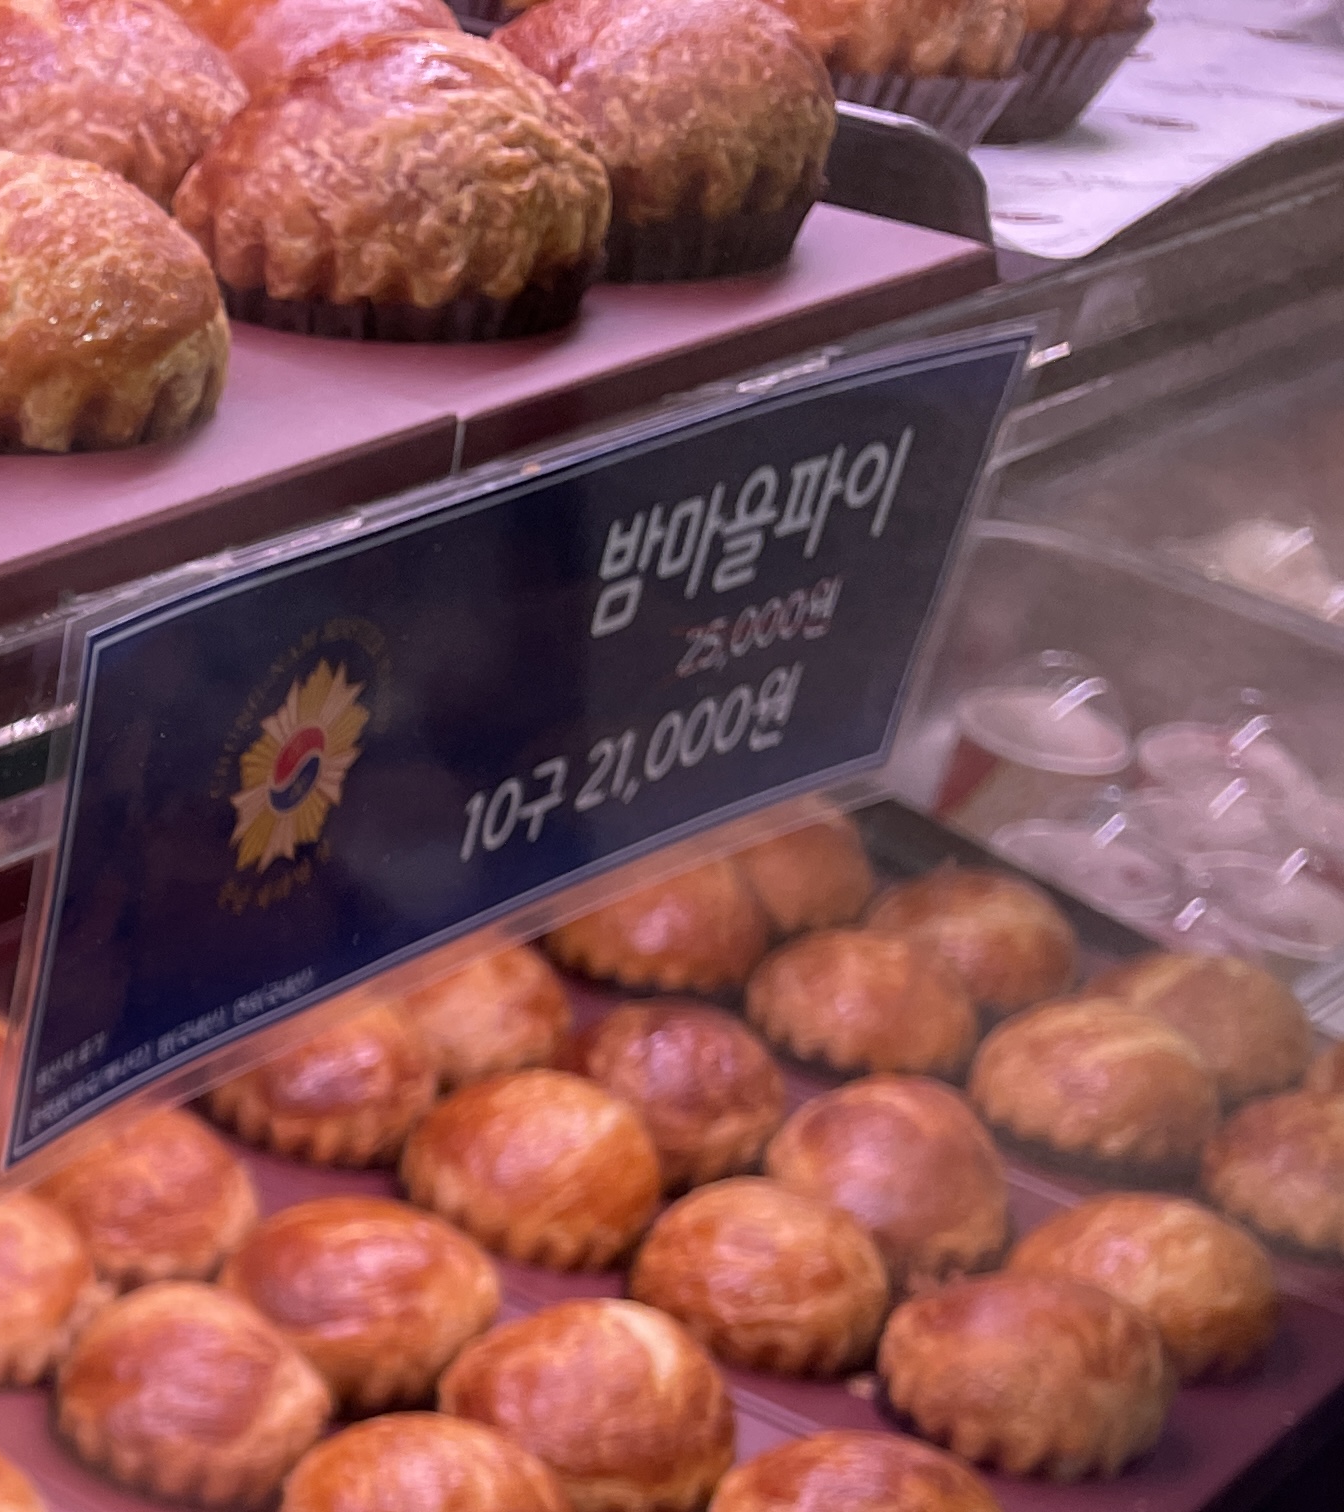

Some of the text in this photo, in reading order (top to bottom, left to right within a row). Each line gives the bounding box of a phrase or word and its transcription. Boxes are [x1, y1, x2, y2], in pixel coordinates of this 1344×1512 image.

[590, 425, 914, 638] 밤마을파이
[460, 661, 805, 863] 10구 21,000원
